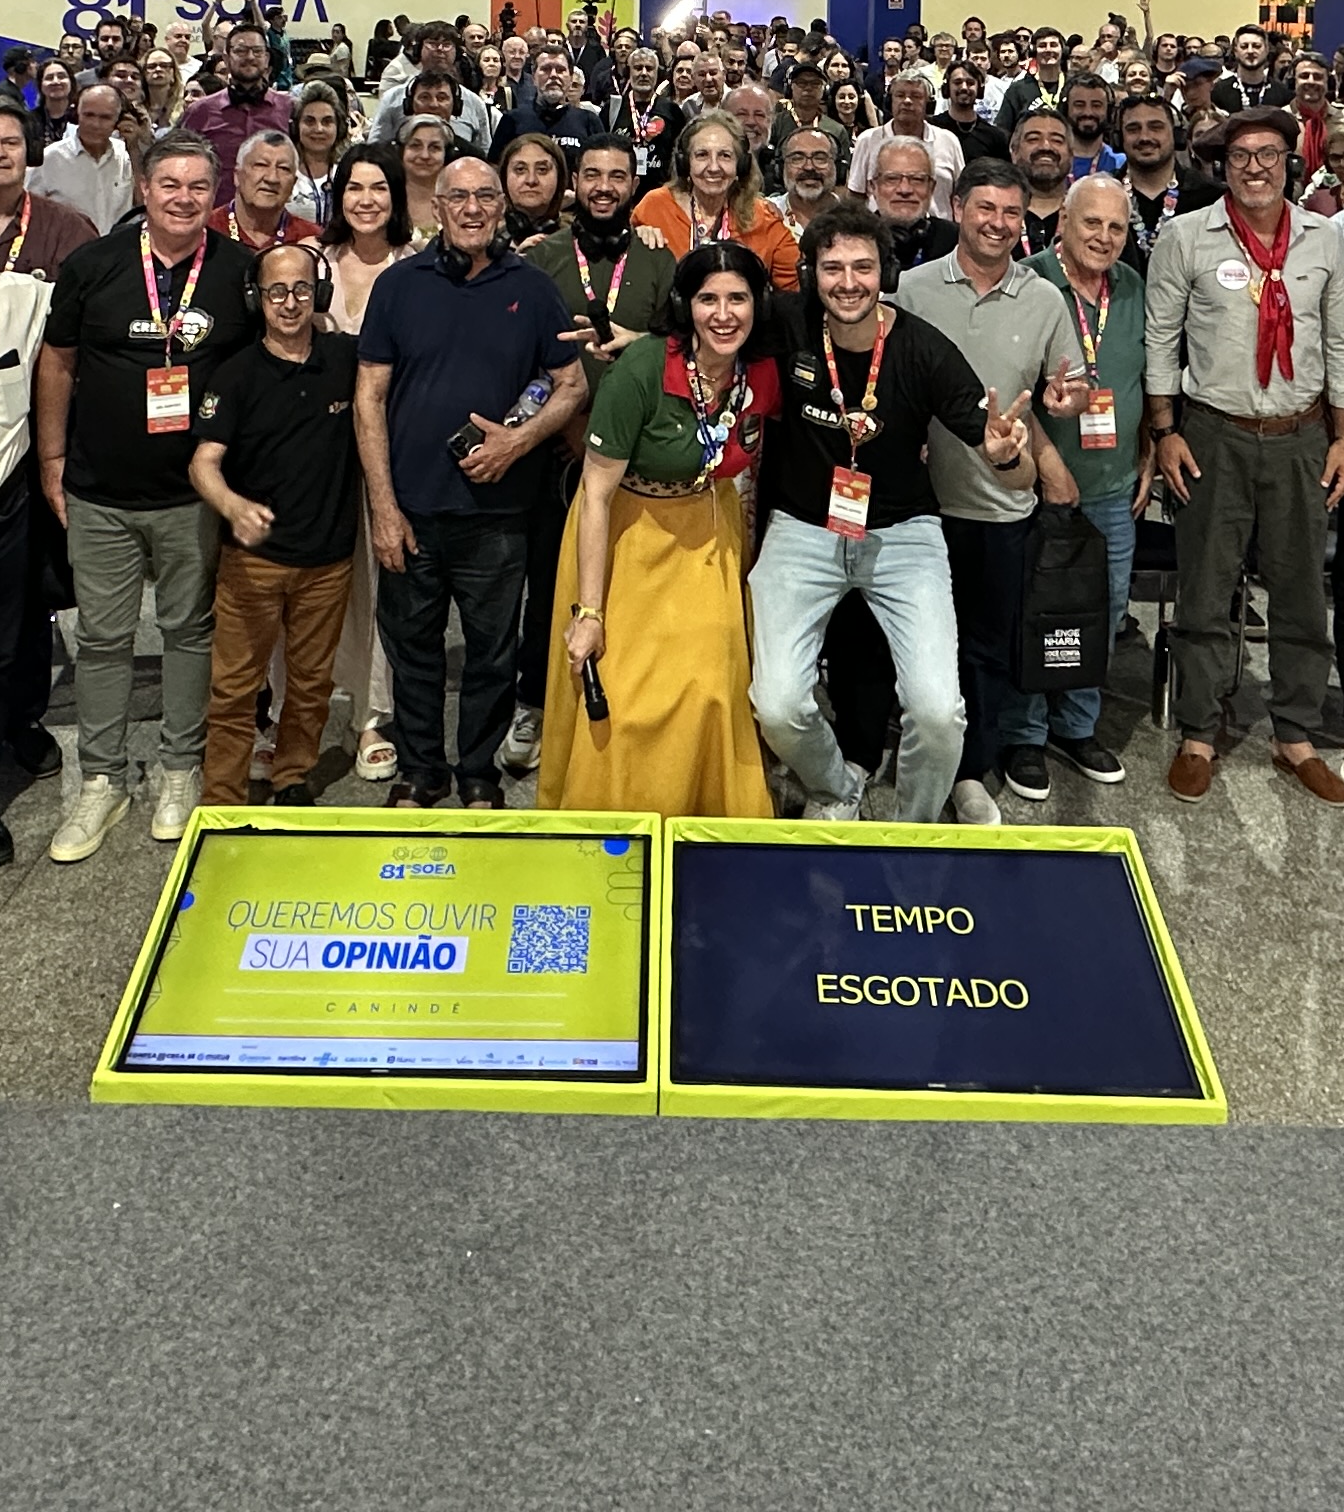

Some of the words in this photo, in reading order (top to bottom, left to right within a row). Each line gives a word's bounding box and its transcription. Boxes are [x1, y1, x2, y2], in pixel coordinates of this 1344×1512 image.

[805, 405, 838, 423] CREA
[227, 900, 397, 932] QUEREMOS
[405, 902, 497, 931] OUVIR
[845, 904, 975, 935] TEMPO
[249, 939, 310, 969] SUA
[321, 934, 457, 971] OPINIÃO
[816, 973, 1029, 1010] ESGOTADO
[325, 1001, 461, 1015] CANINDÉ
